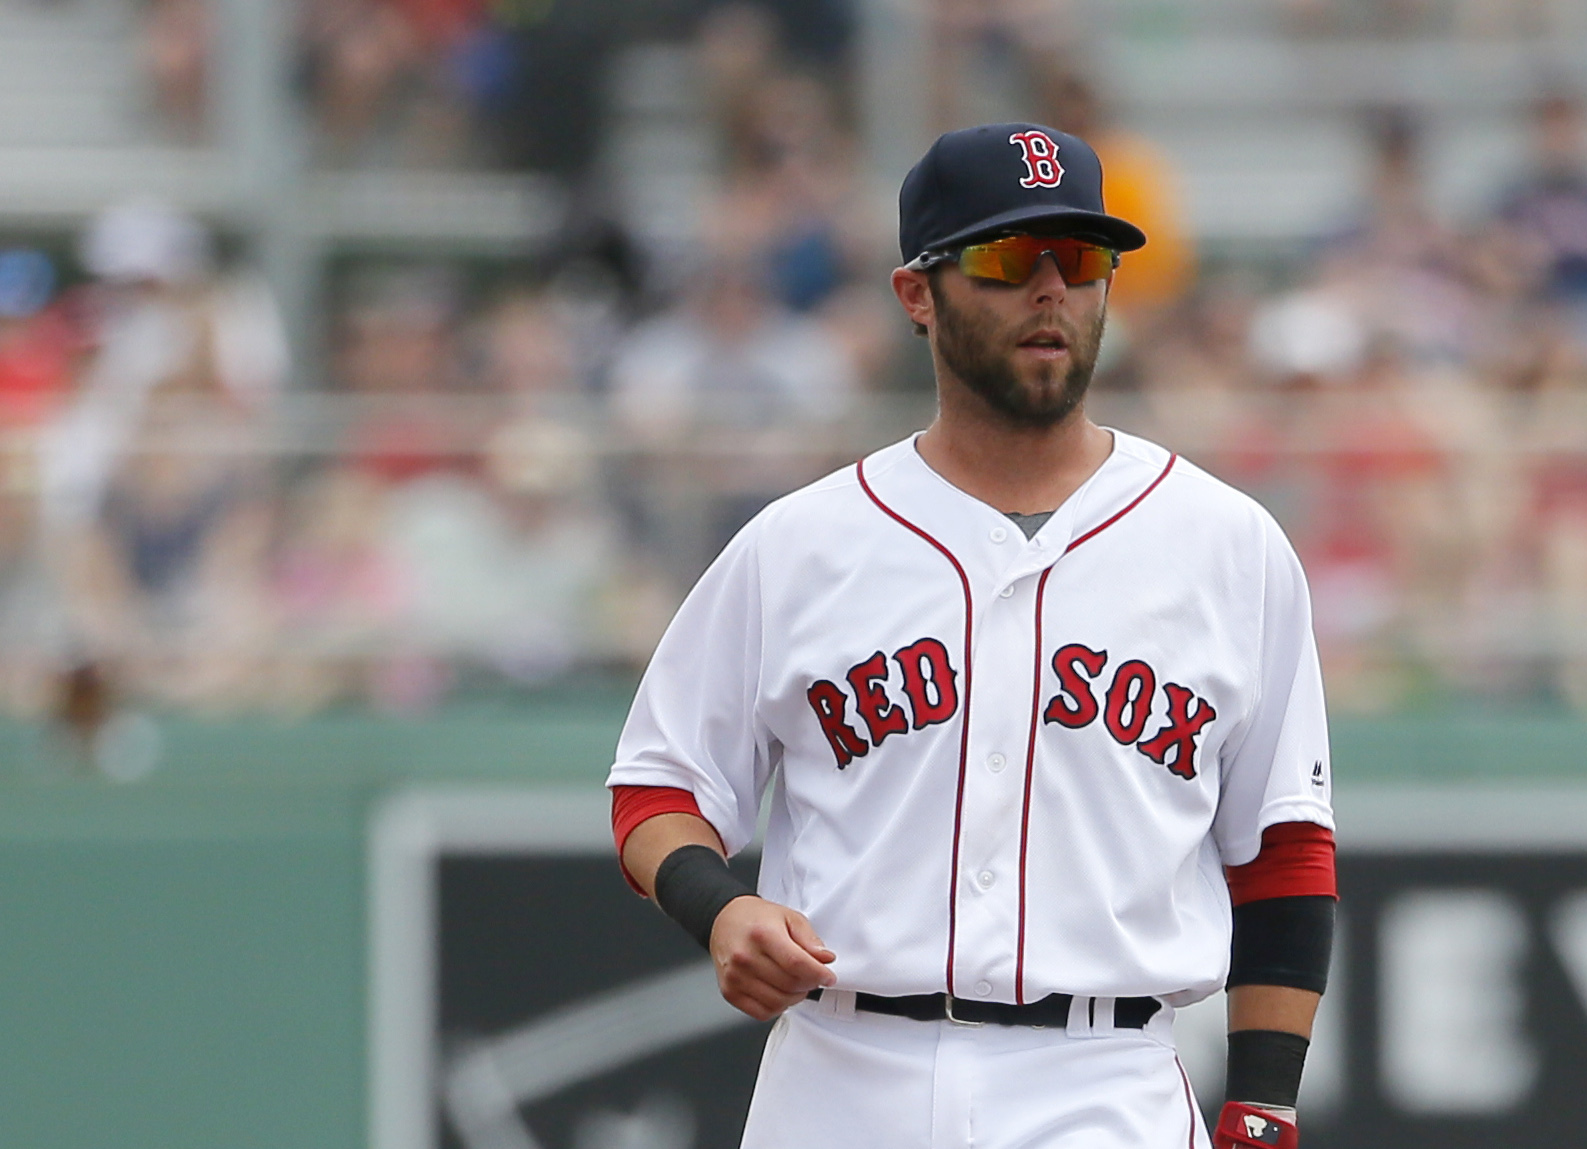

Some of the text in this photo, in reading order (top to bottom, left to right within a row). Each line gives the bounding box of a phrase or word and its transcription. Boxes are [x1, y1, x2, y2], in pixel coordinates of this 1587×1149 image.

[1009, 130, 1065, 189] B
[806, 637, 1216, 780] RED SOX
